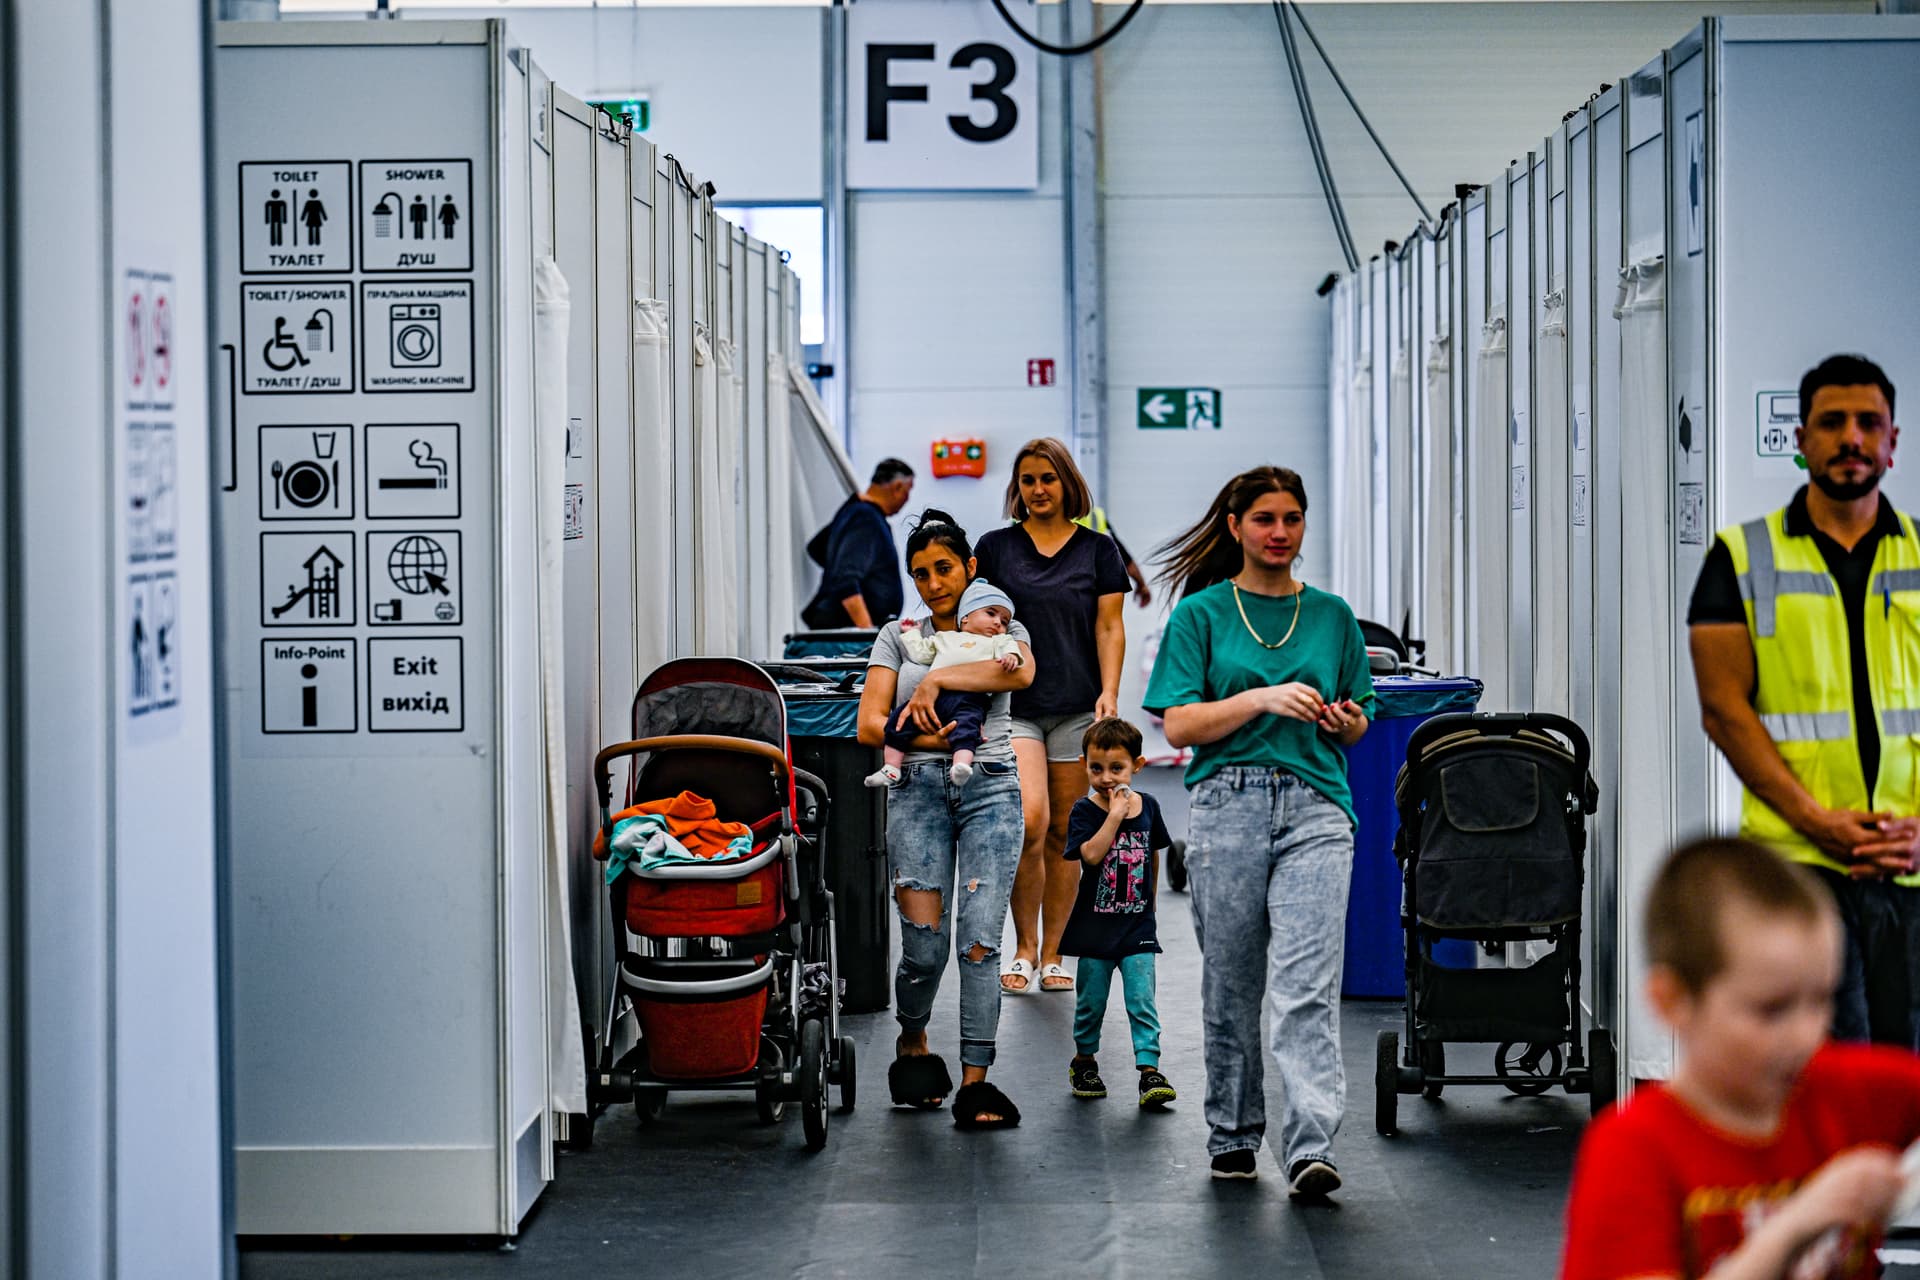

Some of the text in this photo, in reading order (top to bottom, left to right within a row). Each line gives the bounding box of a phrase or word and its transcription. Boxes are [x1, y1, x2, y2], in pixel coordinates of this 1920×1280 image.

[865, 42, 1019, 143] F3
[272, 170, 319, 183] TOILET
[385, 168, 446, 182] SHOWER
[268, 253, 326, 267] ТУАЛЕТ
[396, 252, 437, 267] ДУШ
[370, 375, 465, 386] WASHING MACHINE
[274, 645, 346, 660] Info-Point
[393, 656, 438, 676] Exit
[382, 691, 450, 715] вихід
